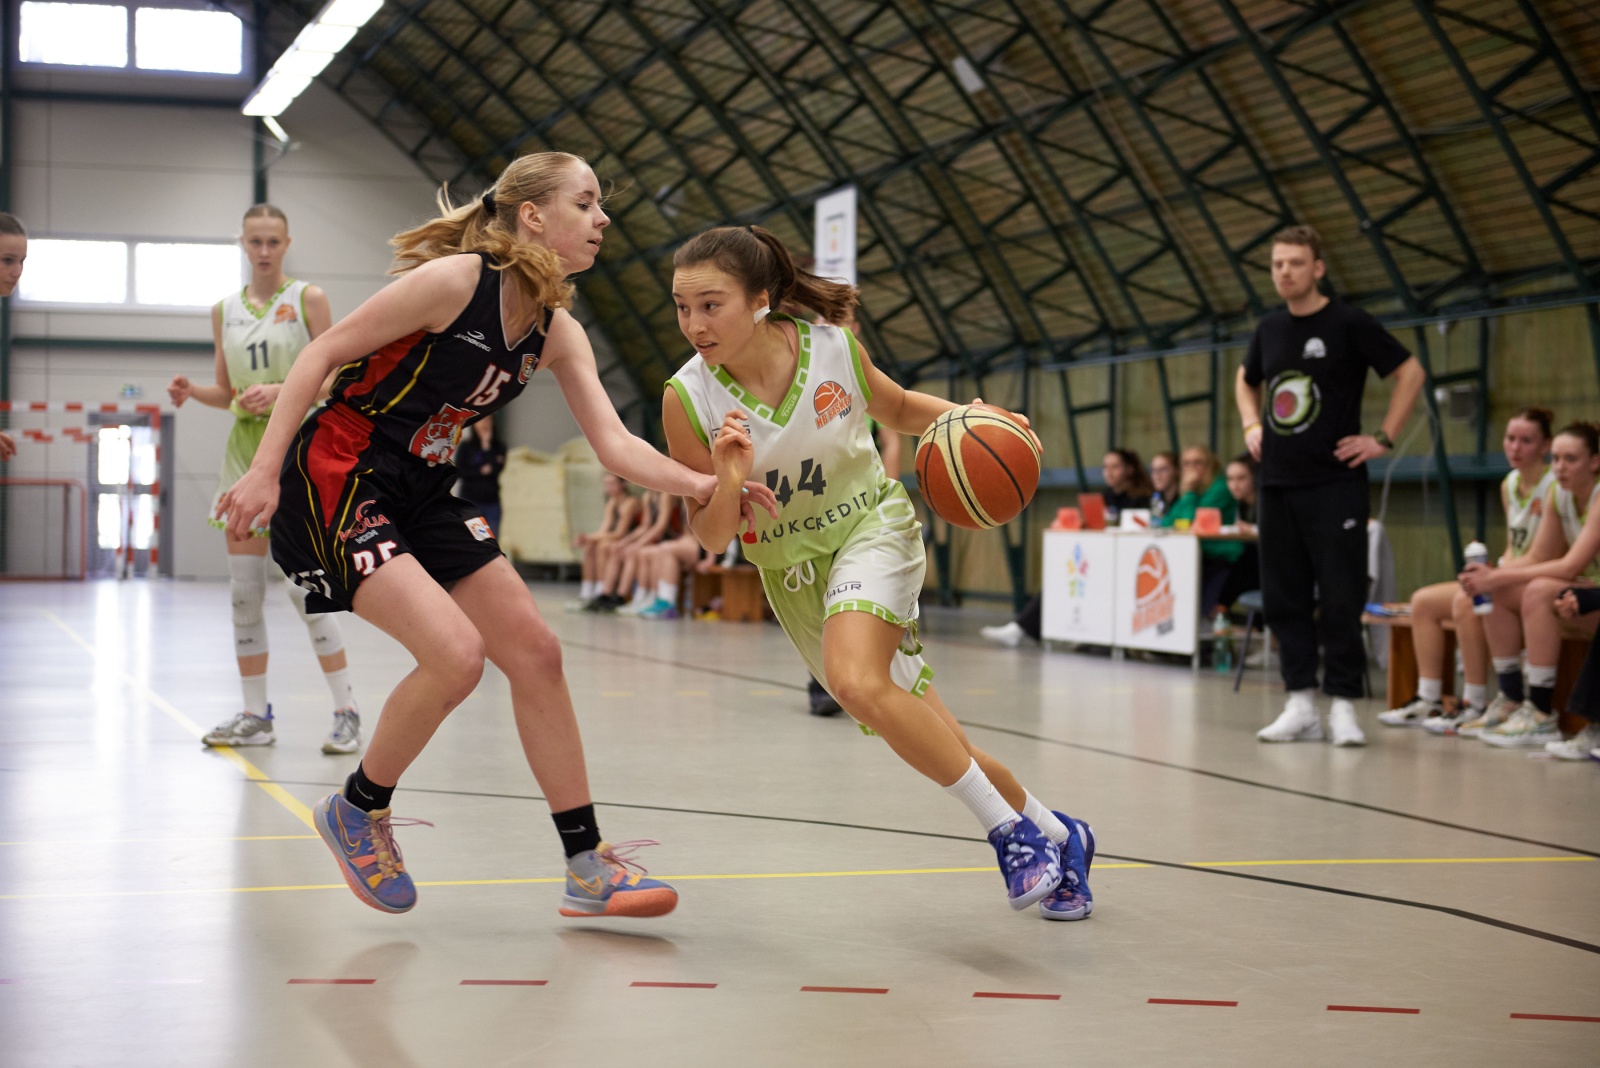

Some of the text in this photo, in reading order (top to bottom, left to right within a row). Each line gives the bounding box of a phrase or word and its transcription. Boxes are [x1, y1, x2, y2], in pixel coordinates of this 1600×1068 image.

[246, 340, 269, 370] 11
[464, 362, 512, 406] 15
[765, 458, 827, 508] 44
[339, 514, 391, 542] VEOLIA
[760, 491, 869, 543] AUKCREDIT
